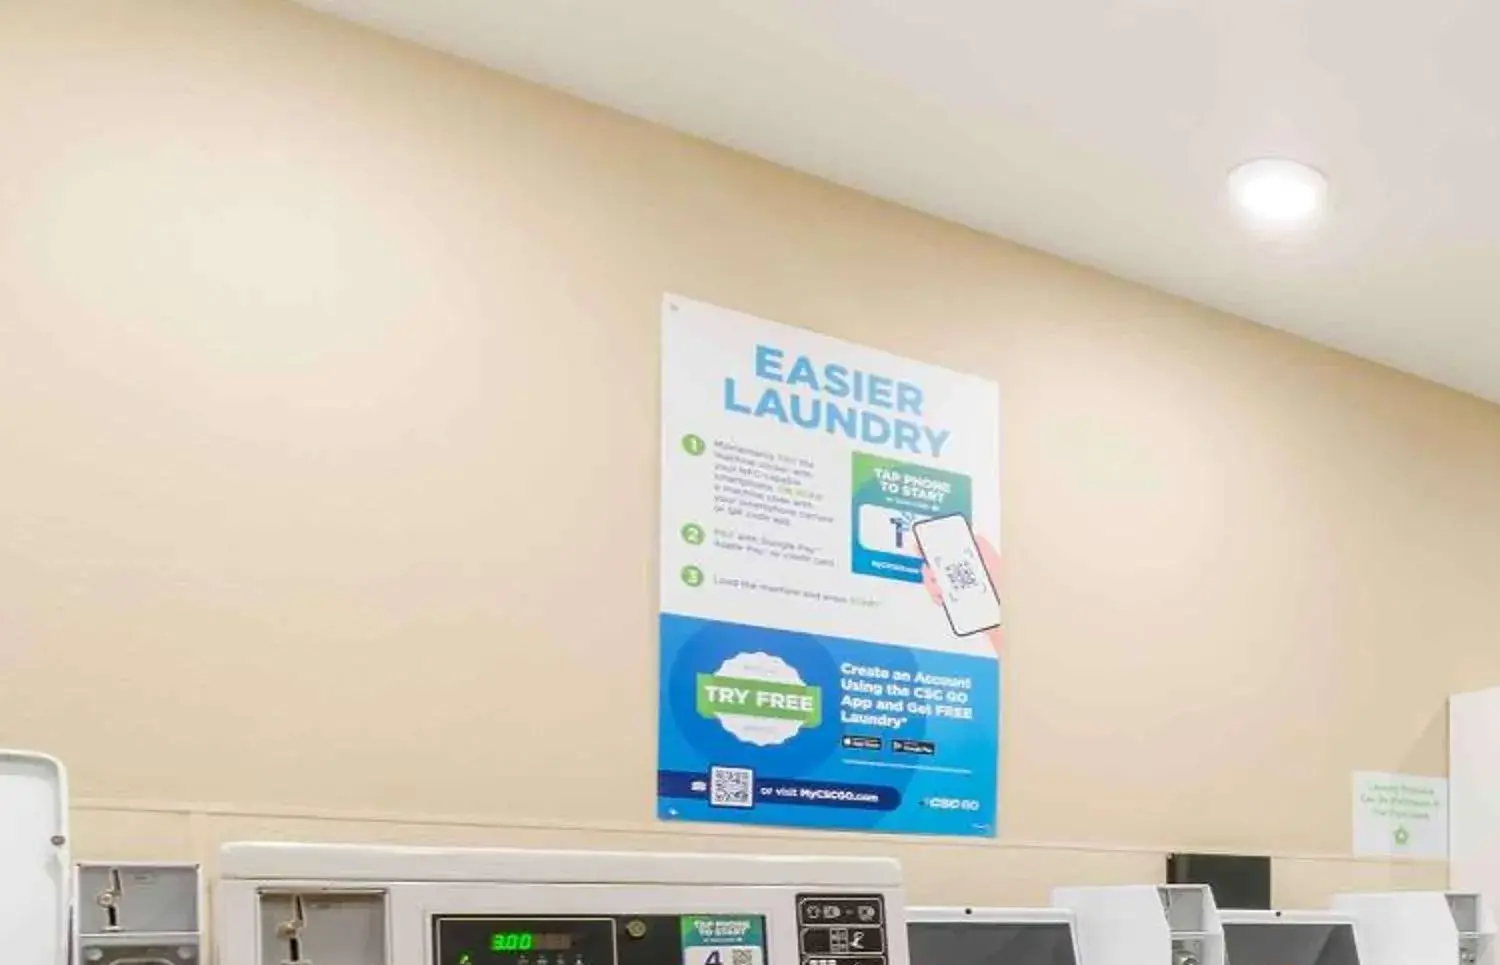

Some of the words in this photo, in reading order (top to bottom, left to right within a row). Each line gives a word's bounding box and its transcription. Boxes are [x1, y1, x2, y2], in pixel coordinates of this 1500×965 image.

[755, 343, 924, 417] EASIER
[724, 377, 951, 458] LAUNDRY
[840, 662, 889, 679] Create
[892, 671, 911, 682] an
[914, 672, 972, 689] Account
[704, 685, 750, 705] TRY
[756, 691, 815, 712] FREE
[841, 678, 883, 696] Using
[887, 684, 910, 697] the
[914, 687, 943, 700] CSC
[946, 691, 968, 703] GO
[840, 695, 873, 710] App
[876, 700, 904, 712] and
[907, 702, 932, 716] Get
[936, 704, 973, 720] FREE
[760, 787, 773, 796] or
[776, 787, 798, 798] visit
